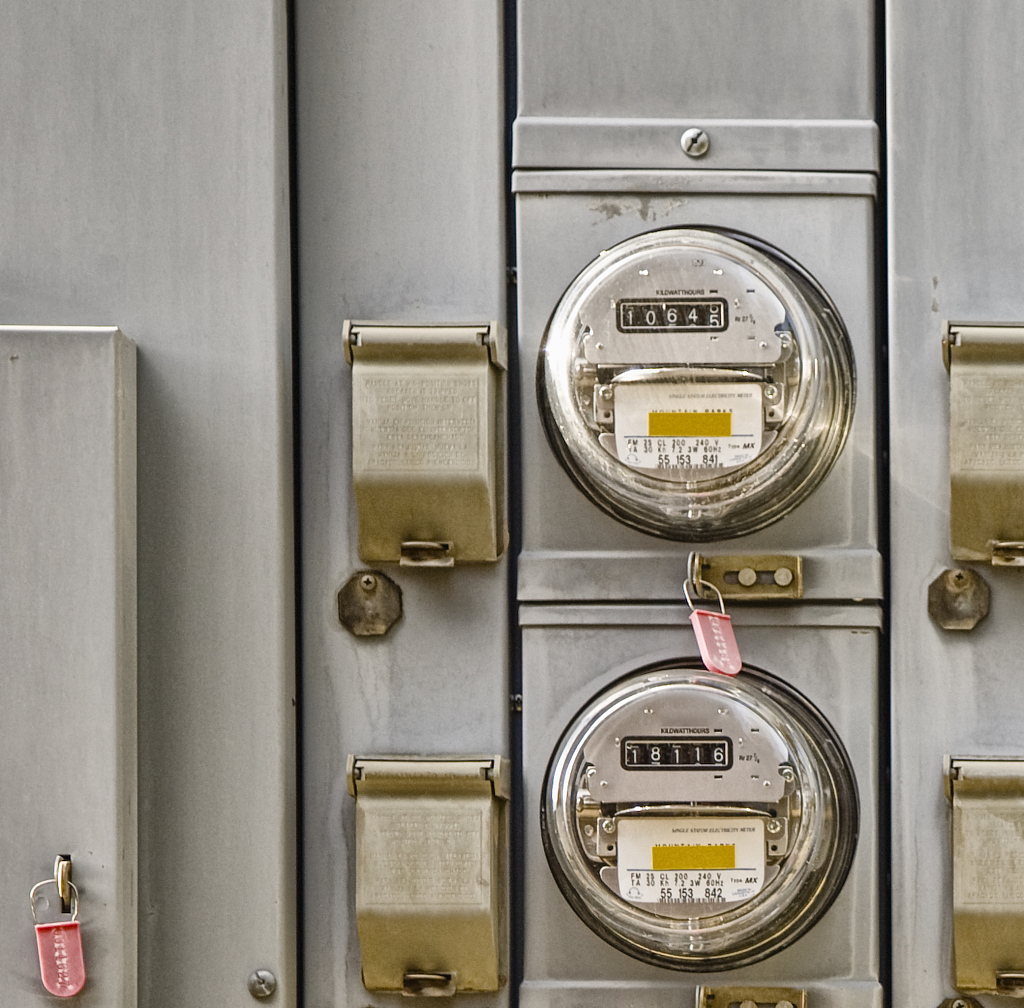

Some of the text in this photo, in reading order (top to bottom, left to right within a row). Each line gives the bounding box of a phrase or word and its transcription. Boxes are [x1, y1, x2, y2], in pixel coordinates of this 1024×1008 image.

[658, 455, 718, 465] 55 153 841
[632, 747, 724, 763] 18116
[661, 888, 672, 898] 55
[679, 888, 693, 898] 153
[705, 888, 722, 898] 842
